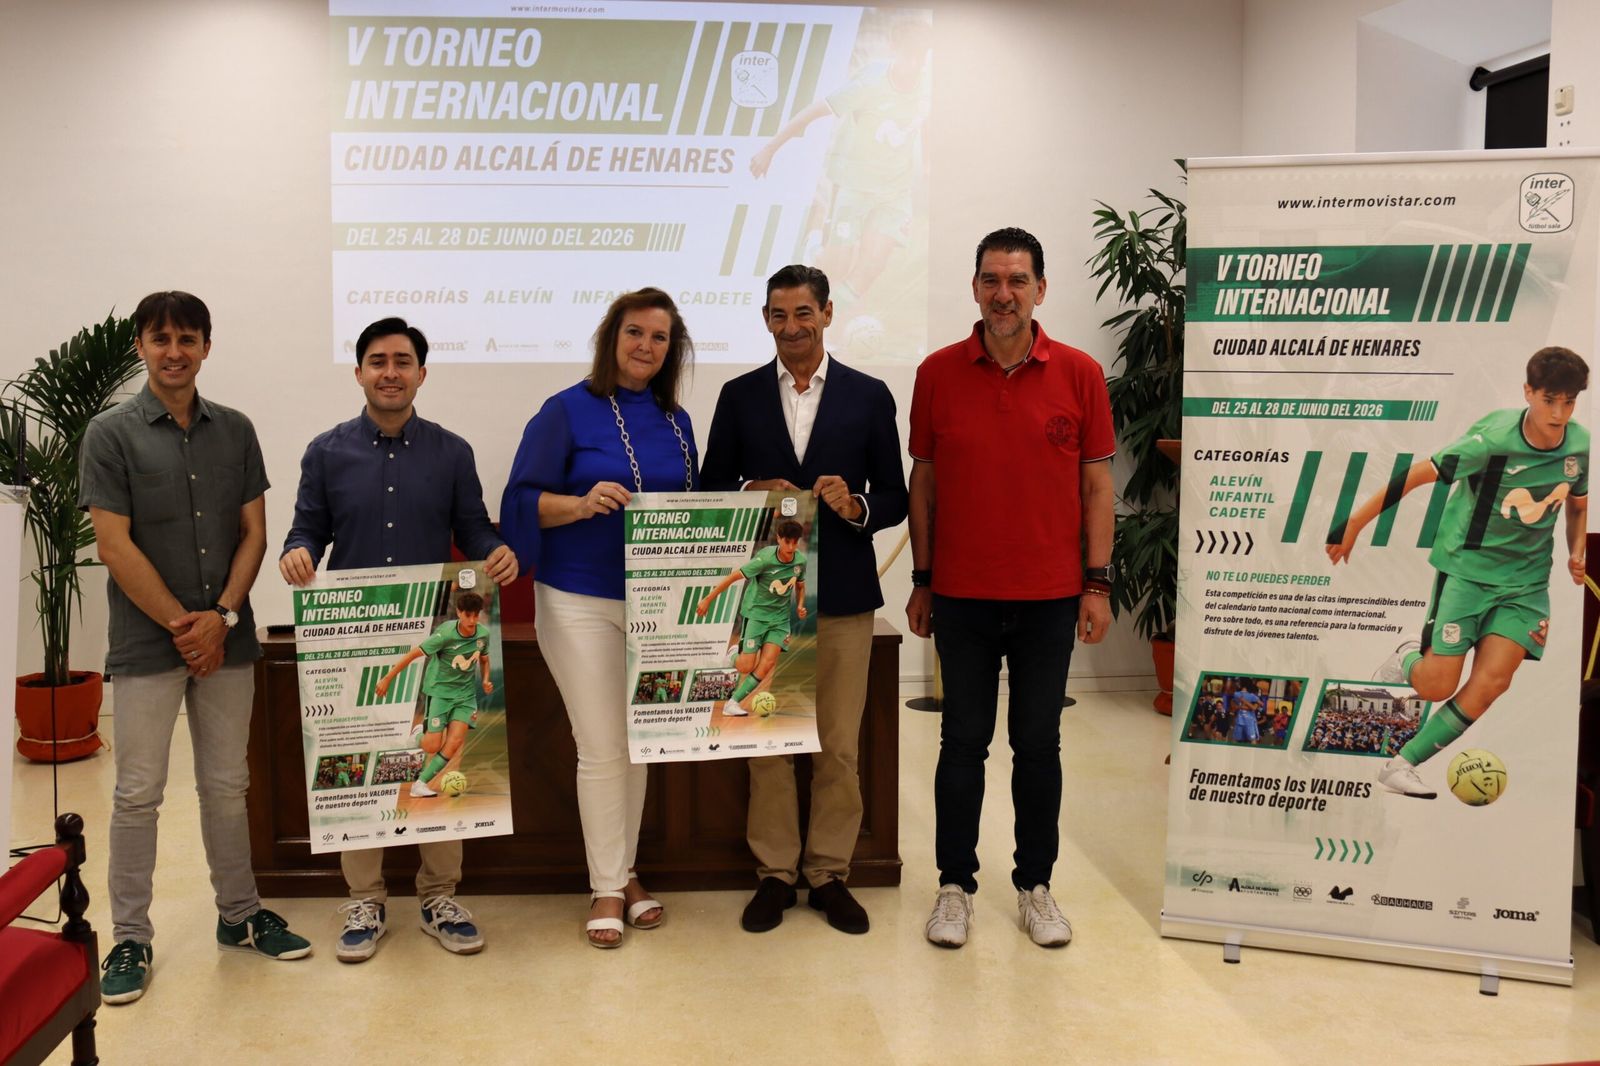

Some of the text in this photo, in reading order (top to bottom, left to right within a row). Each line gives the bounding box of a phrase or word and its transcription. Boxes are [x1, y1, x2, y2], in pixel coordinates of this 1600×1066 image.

[347, 26, 542, 68] V TORNEO
[739, 55, 771, 66] inter
[344, 80, 664, 122] INTERNACIONAL
[344, 140, 736, 174] CIUDAD ALCALÁ DE HENARES
[1530, 177, 1566, 190] inter
[1277, 194, 1456, 209] www.intermovistar.com
[346, 227, 635, 247] DEL 25 AL 28 DE JUNIO DEL 2026
[1217, 253, 1323, 282] V TORNEO
[346, 286, 469, 305] CATEGORÍAS
[484, 286, 554, 304] ALEVÍN
[679, 290, 753, 305] CADETE
[1214, 287, 1391, 316] INTERNACIONAL
[1213, 335, 1421, 357] CIUDAD ALCALÁ DE HENARES
[1212, 401, 1383, 418] DEL 25 AL 28 DE JUNIO DEL 2026
[1193, 448, 1290, 463] CATEGORÍAS
[1209, 473, 1263, 488] ALEVÍN
[1209, 491, 1275, 504] INFANTIL
[632, 511, 691, 525] V TORNEO
[1209, 506, 1266, 519] CADETE
[632, 526, 726, 541] INTERNACIONAL
[631, 543, 747, 556] CIUDAD ALCALÁ DE HENARES
[667, 569, 675, 577] DE
[1206, 570, 1331, 587] NO TE LO PUEDES PERDER
[632, 585, 671, 593] CATEGORÍAS
[301, 589, 363, 606] V TORNEO
[1205, 589, 1221, 598] Esta
[1222, 590, 1268, 601] competición
[1294, 593, 1304, 602] de
[1305, 594, 1316, 602] las
[1317, 595, 1336, 604] citas
[1337, 595, 1399, 607] imprescindibles
[1400, 599, 1426, 608] dentro
[302, 602, 402, 623] INTERNACIONAL
[1205, 602, 1387, 619] del calendario tanto nacional como internacional.
[302, 620, 426, 638] CIUDAD ALCALÁ DE HENARES
[1204, 614, 1222, 623] Pero
[1223, 615, 1244, 624] sobre
[1275, 619, 1289, 627] una
[1290, 619, 1329, 628] referencia
[1329, 622, 1350, 631] para
[1349, 622, 1356, 630] la
[1357, 623, 1397, 633] formación
[1204, 627, 1320, 641] disfrute de los jóvenes talentos.
[304, 653, 316, 661] DEL
[316, 652, 325, 660] 25
[325, 651, 333, 659] AL
[342, 650, 350, 658] DE
[351, 649, 369, 658] JUNIO
[369, 648, 380, 656] DEL
[305, 667, 347, 676] CATEGORÍAS
[633, 706, 711, 717] Fomentamos los VALORES
[633, 715, 693, 725] de nuestro deporte
[1189, 768, 1372, 799] Fomentamos los VALORES
[315, 788, 398, 803] Fomentamos los VALORES
[1189, 785, 1327, 813] de nuestro deporte
[315, 798, 378, 811] de nuestro deporte
[1380, 896, 1433, 911] BAUHAUS
